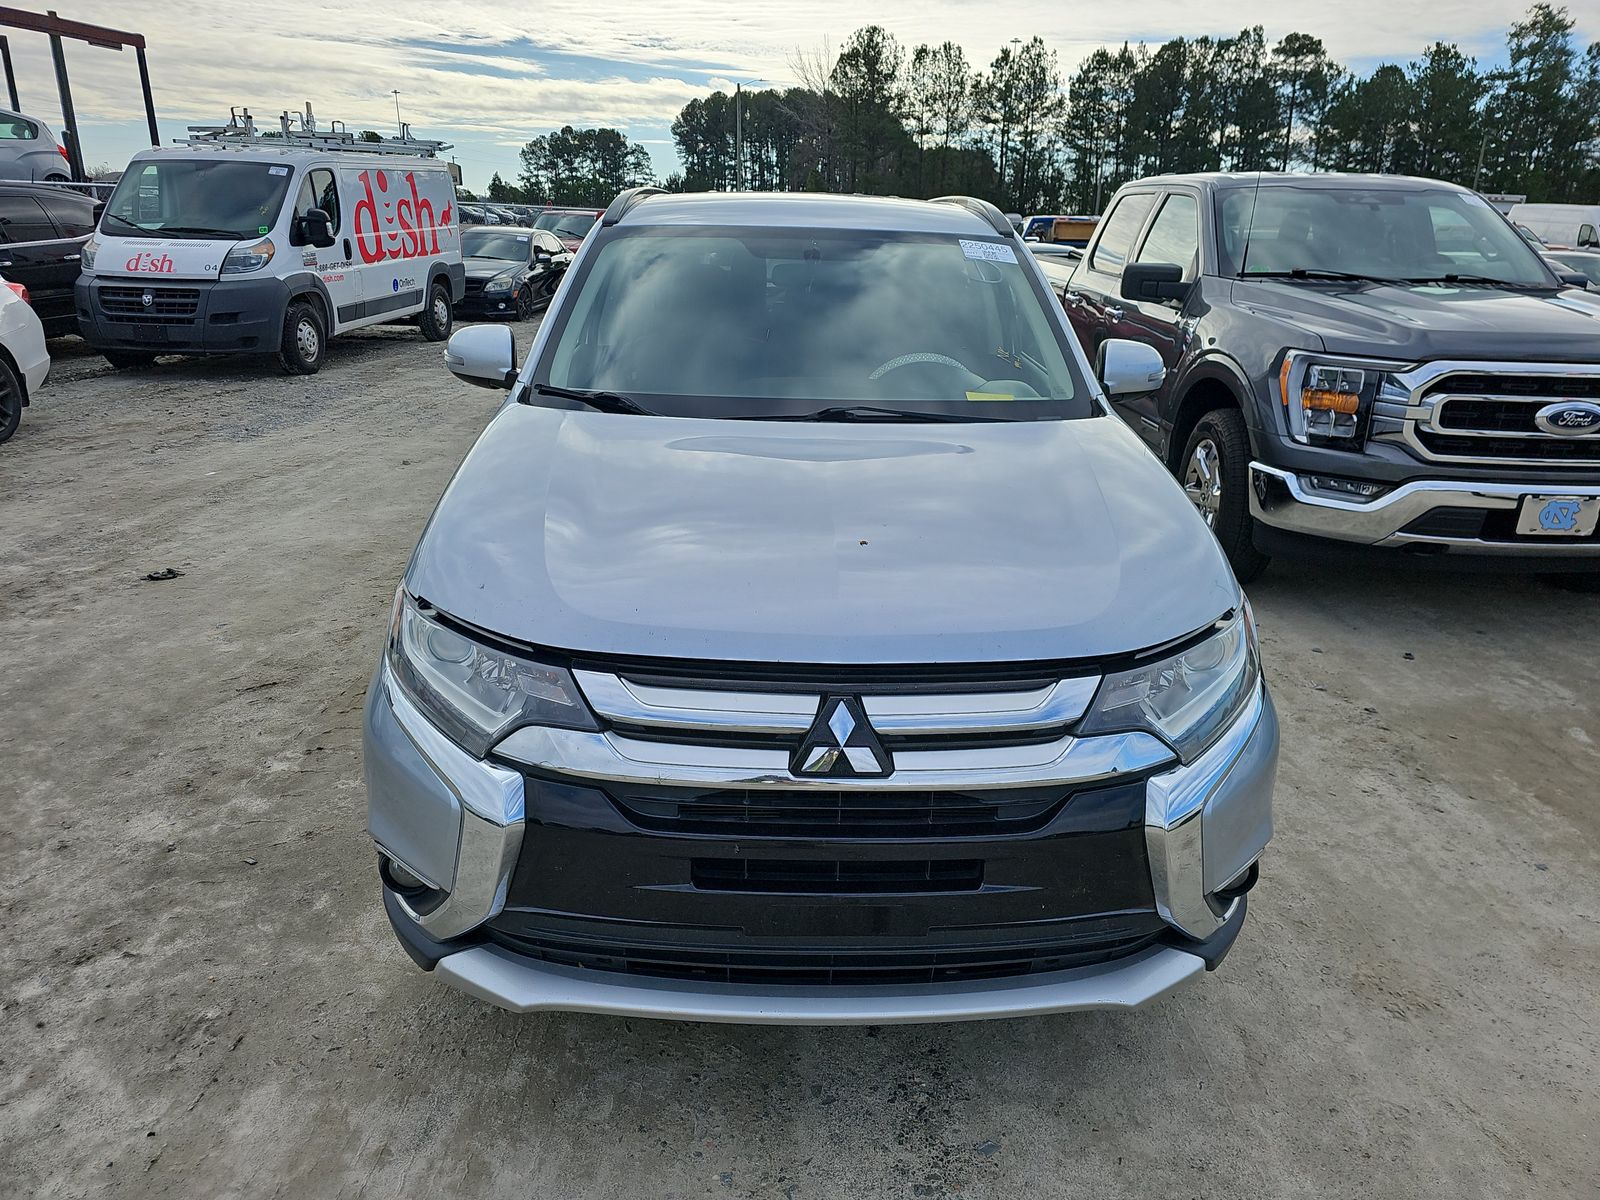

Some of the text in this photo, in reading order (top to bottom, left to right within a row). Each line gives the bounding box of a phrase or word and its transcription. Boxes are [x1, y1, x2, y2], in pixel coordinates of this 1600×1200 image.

[354, 169, 440, 265] dish
[125, 252, 174, 273] dish
[204, 264, 218, 272] 04
[1557, 410, 1594, 426] Ford
